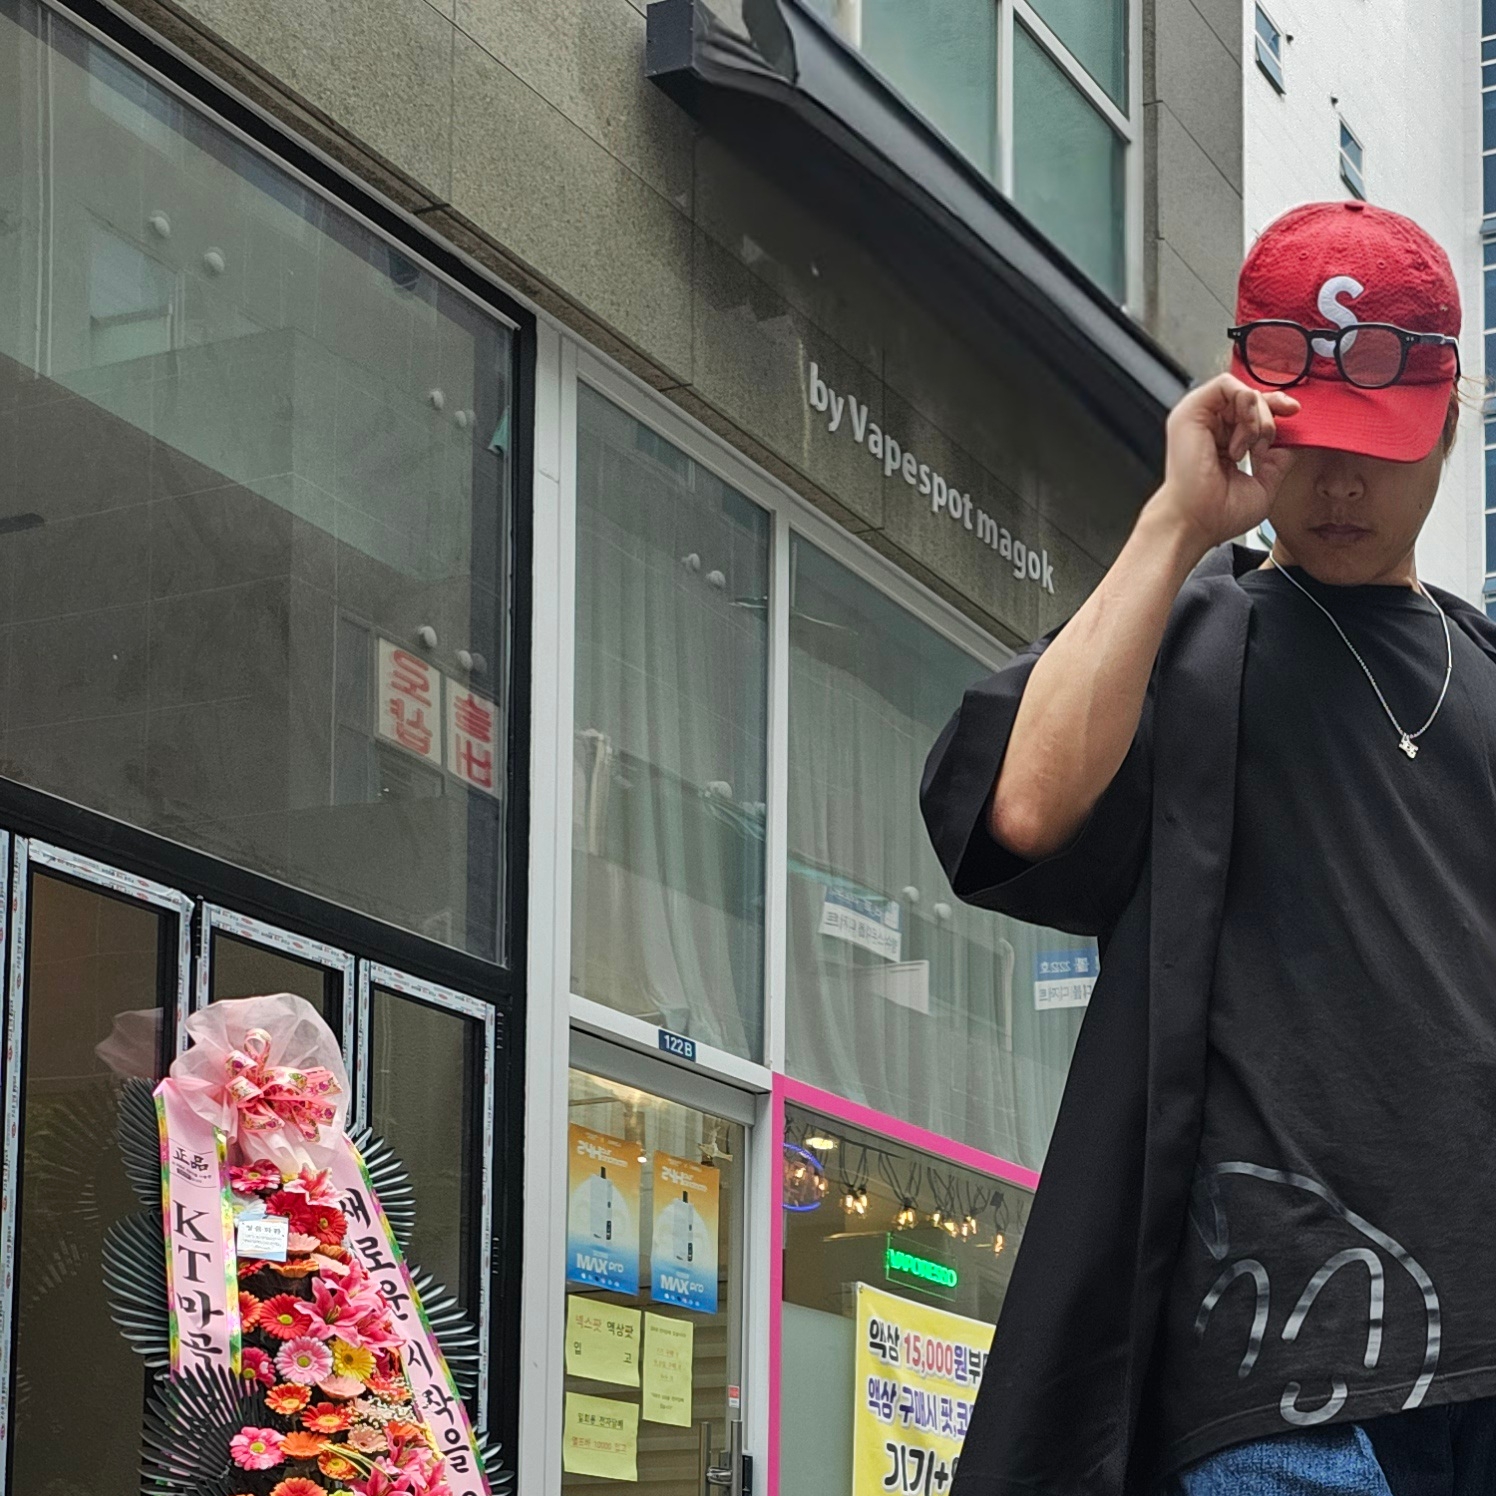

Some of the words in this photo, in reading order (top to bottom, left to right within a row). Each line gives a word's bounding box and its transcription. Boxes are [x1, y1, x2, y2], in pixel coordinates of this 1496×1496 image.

[1312, 275, 1365, 359] S
[810, 361, 845, 432] by
[848, 394, 973, 531] Vapespot
[977, 508, 1055, 595] magok
[664, 1034, 692, 1057] 122B
[173, 1199, 225, 1380] KT마곡
[576, 1253, 608, 1275] MAX
[660, 1274, 690, 1295] MAX
[340, 1188, 409, 1320] 새로운
[408, 1339, 470, 1473] 시작을
[869, 1318, 900, 1363] 액상
[868, 1377, 897, 1420] 액상
[899, 1386, 938, 1430] 구매시
[941, 1397, 975, 1437] 팟,코
